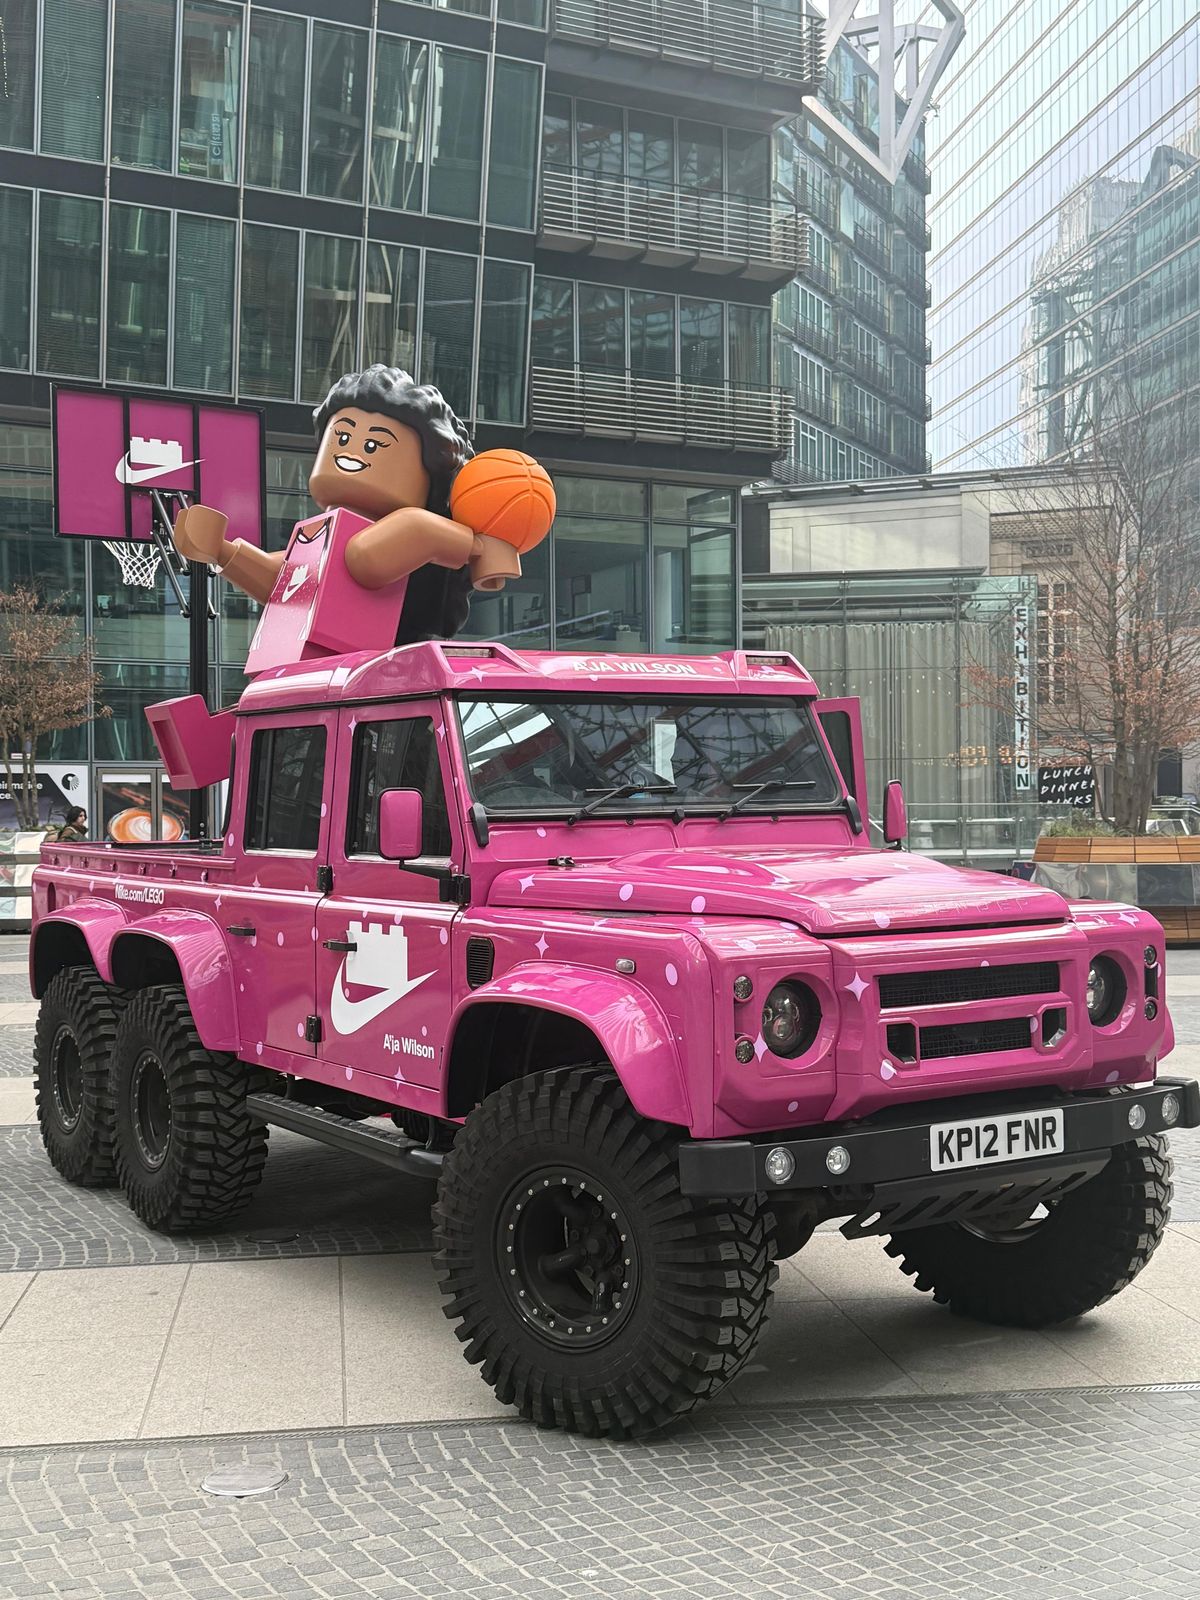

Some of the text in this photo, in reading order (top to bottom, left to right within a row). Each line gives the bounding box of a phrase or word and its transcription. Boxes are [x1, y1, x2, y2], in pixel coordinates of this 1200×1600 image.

[573, 661, 697, 675] A'JA WILSON
[1016, 608, 1029, 788] EXHIBITION
[1043, 765, 1092, 780] LUNCH
[1046, 795, 1092, 805] INKS
[115, 884, 165, 905] Nike.com/LEGO
[383, 1033, 435, 1059] A'ja Wilson
[938, 1116, 1057, 1164] KP12 FNR
